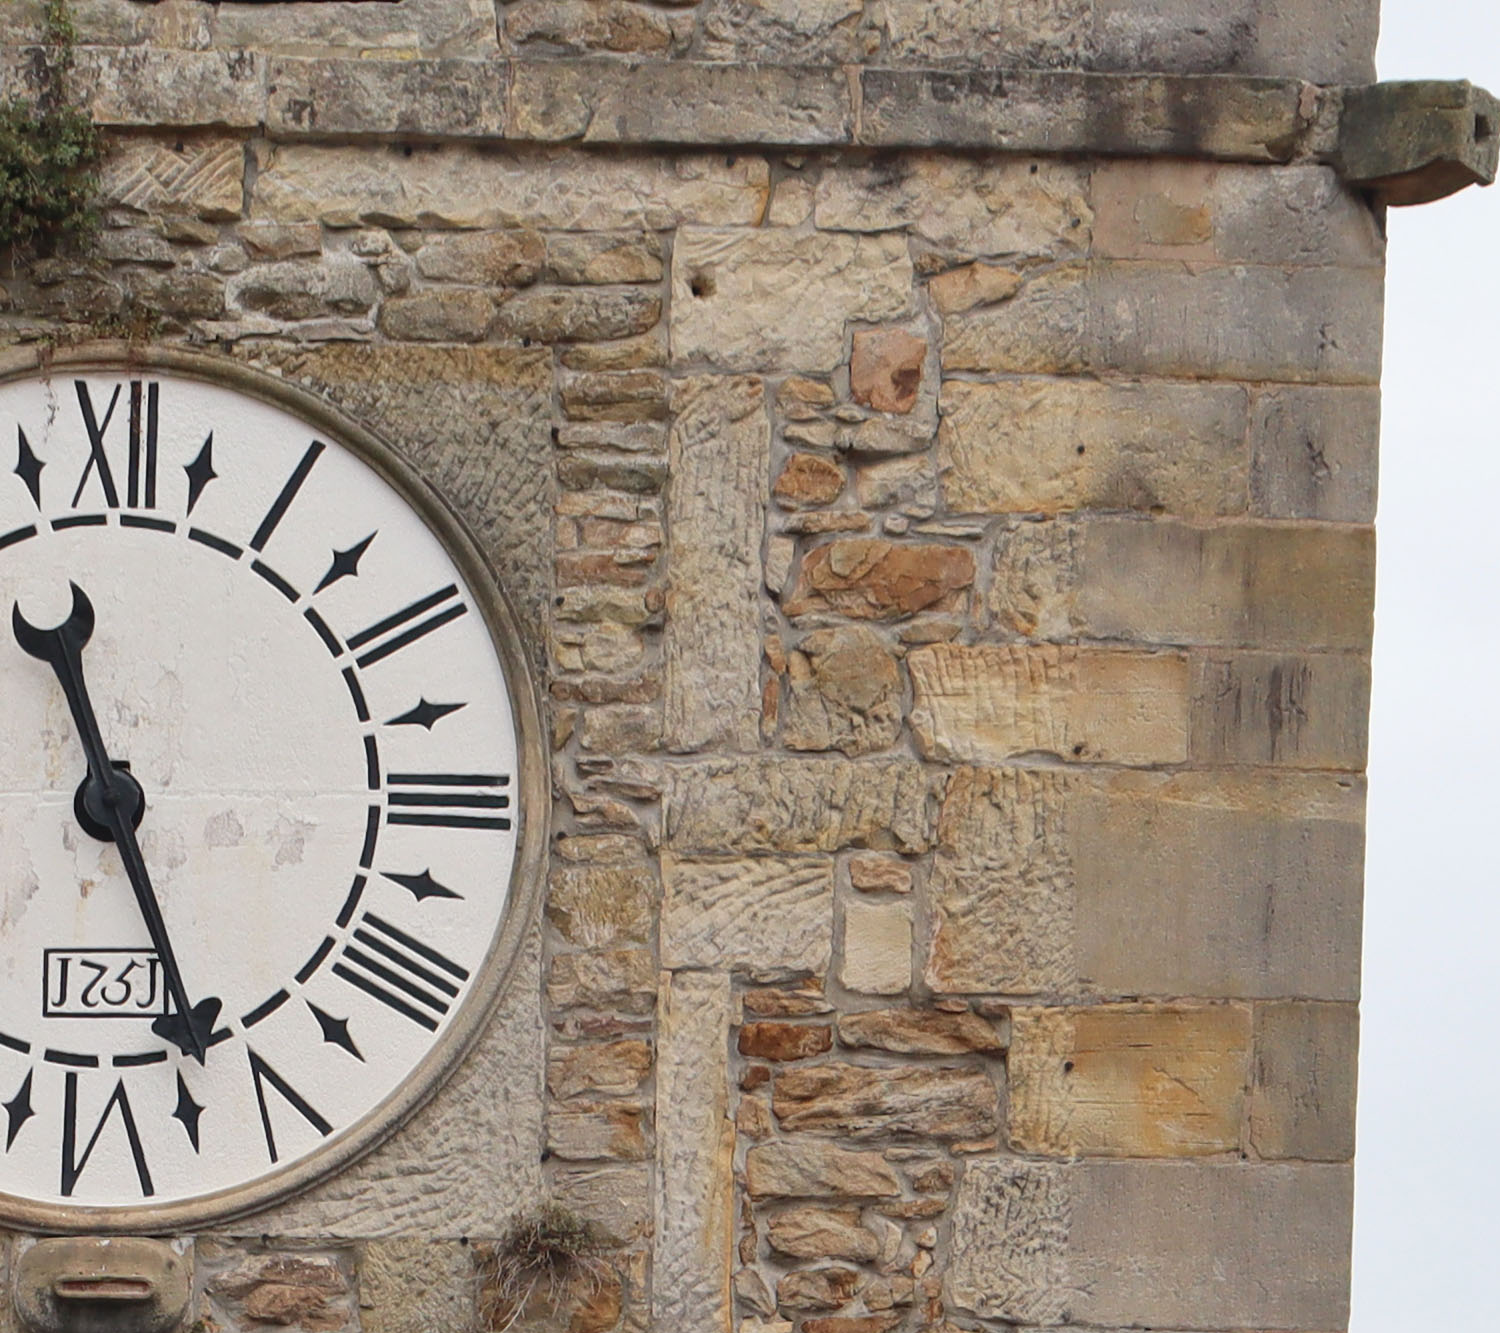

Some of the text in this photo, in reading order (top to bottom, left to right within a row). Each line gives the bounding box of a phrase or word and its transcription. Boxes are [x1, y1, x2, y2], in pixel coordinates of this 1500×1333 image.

[72, 380, 159, 509] XII
[345, 583, 468, 668] II
[387, 773, 511, 831] III
[332, 912, 470, 1032] IIII
[61, 1071, 155, 1198] VI
[247, 1042, 334, 1163] V
